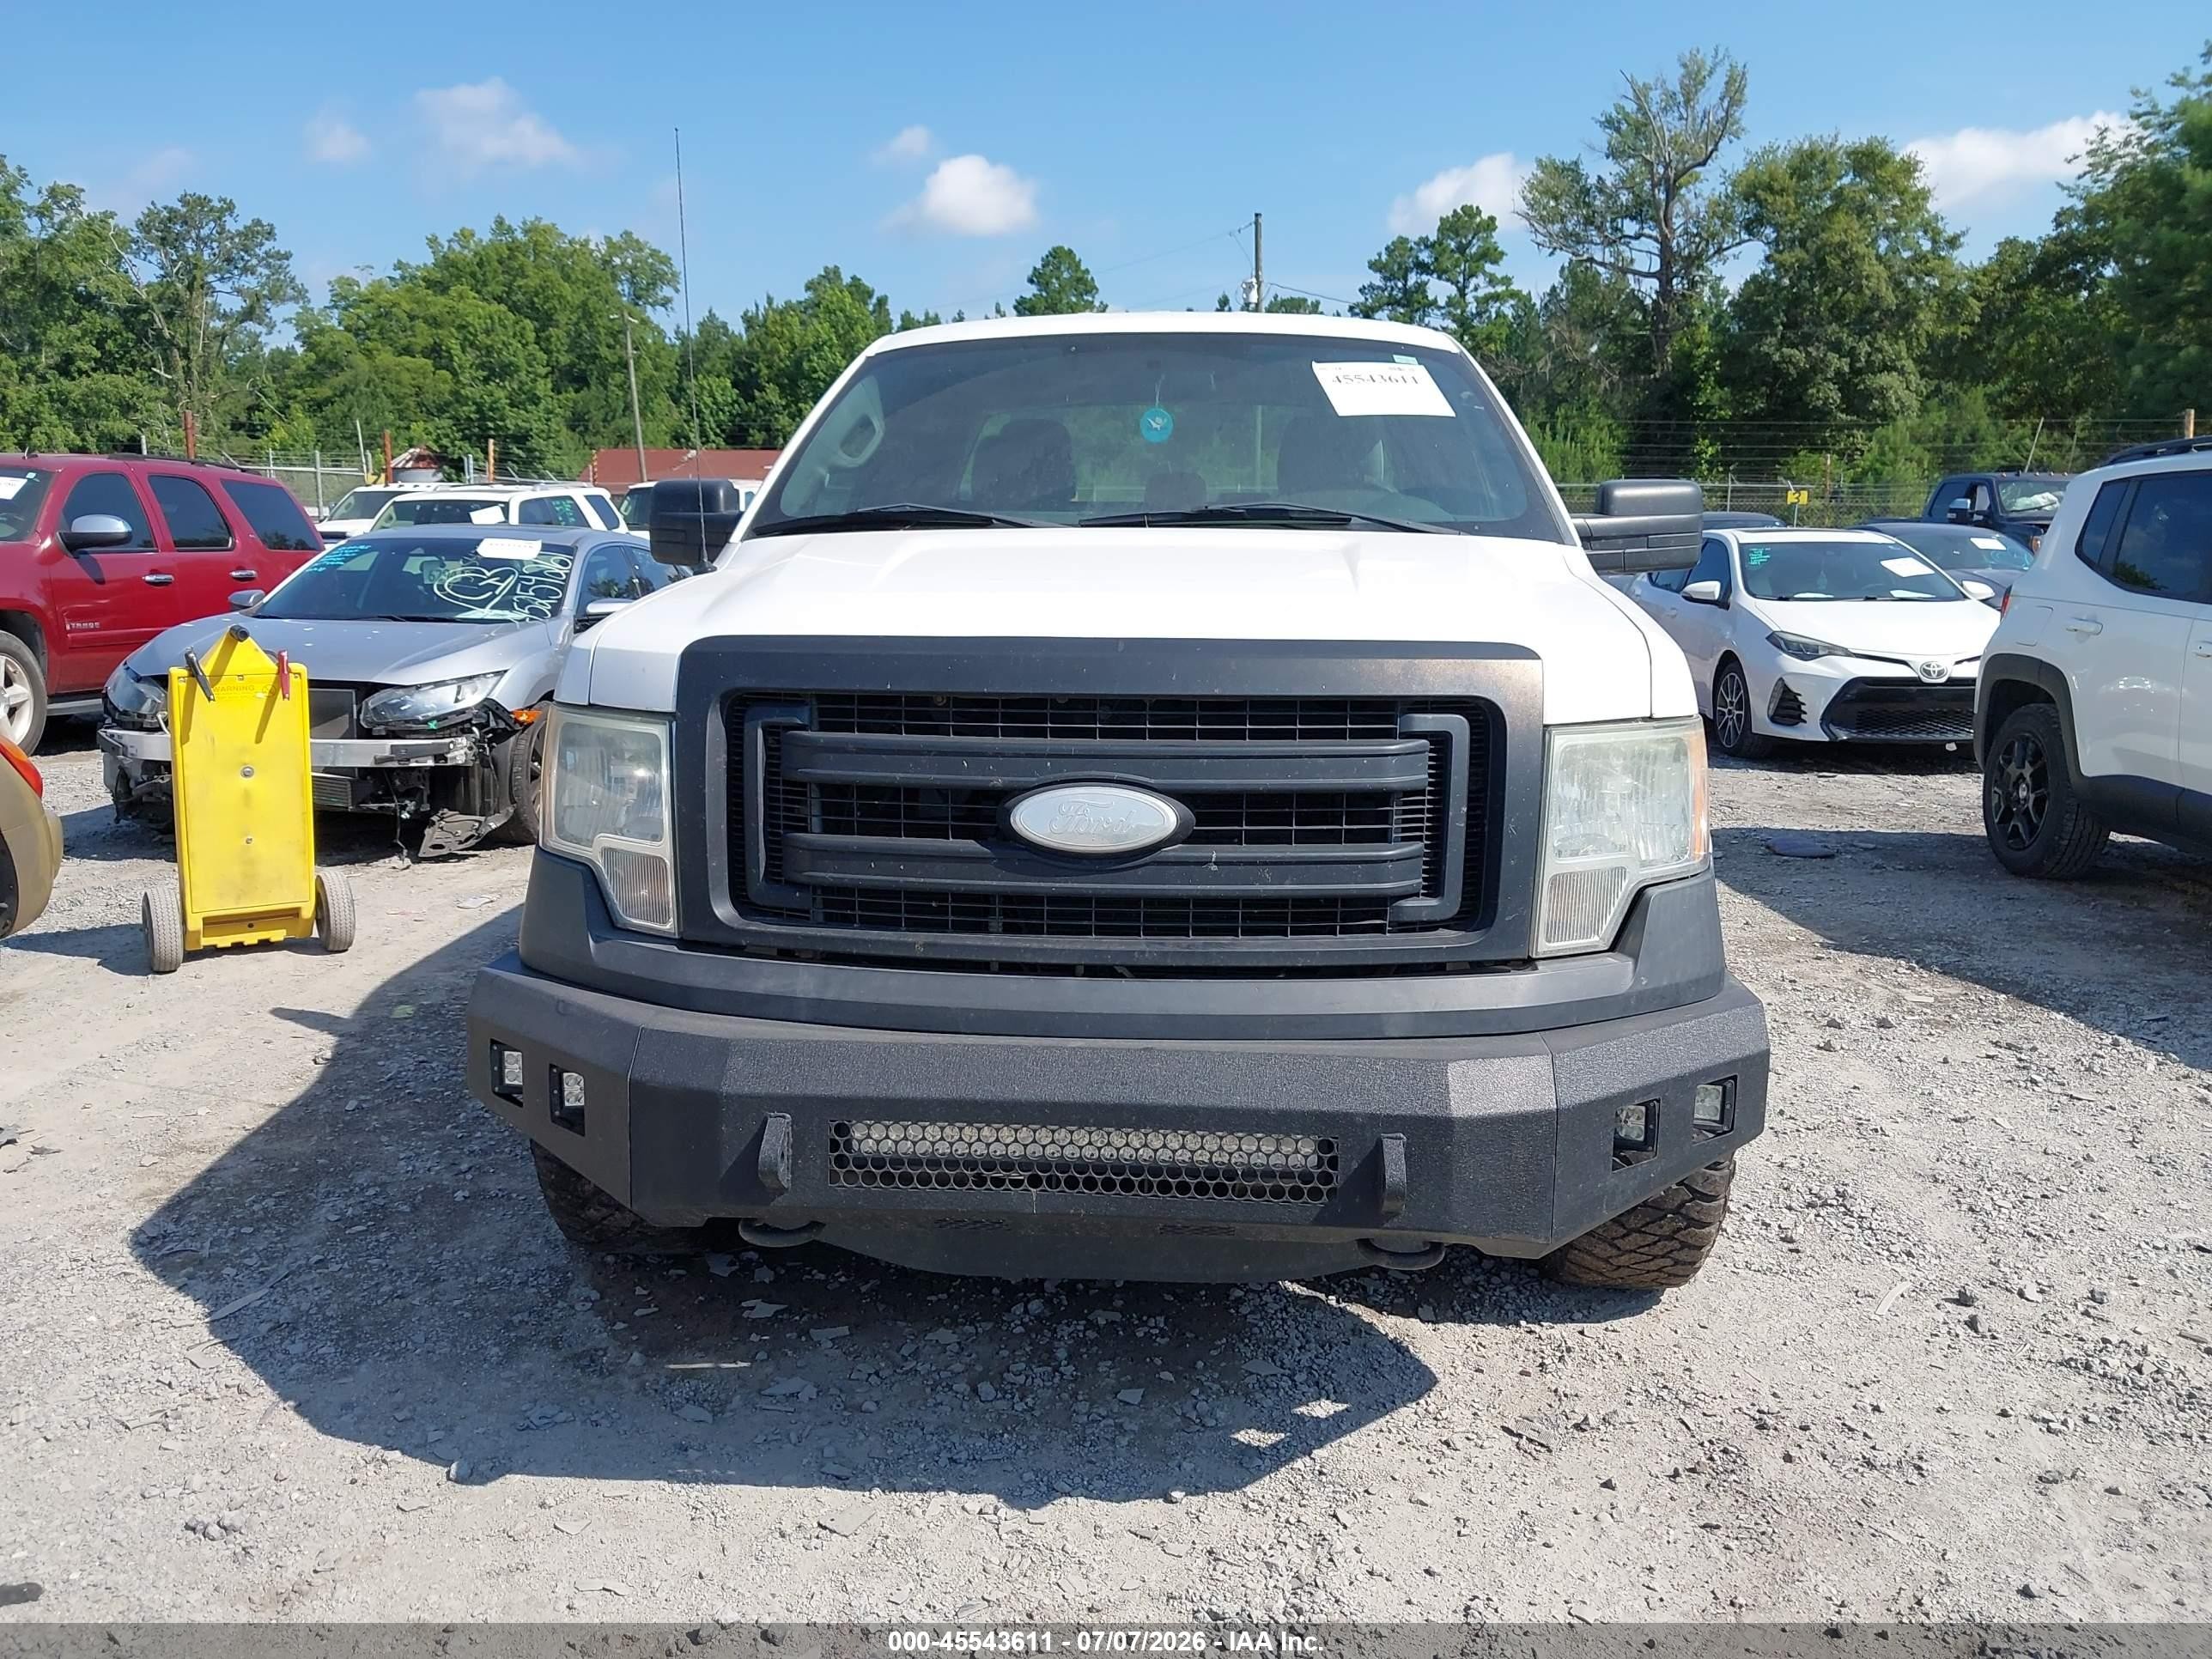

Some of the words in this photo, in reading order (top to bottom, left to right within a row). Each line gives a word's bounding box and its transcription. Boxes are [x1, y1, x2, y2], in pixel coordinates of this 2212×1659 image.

[1791, 491, 1802, 504] 3
[213, 684, 255, 694] WARNING
[1048, 799, 1138, 835] Ford
